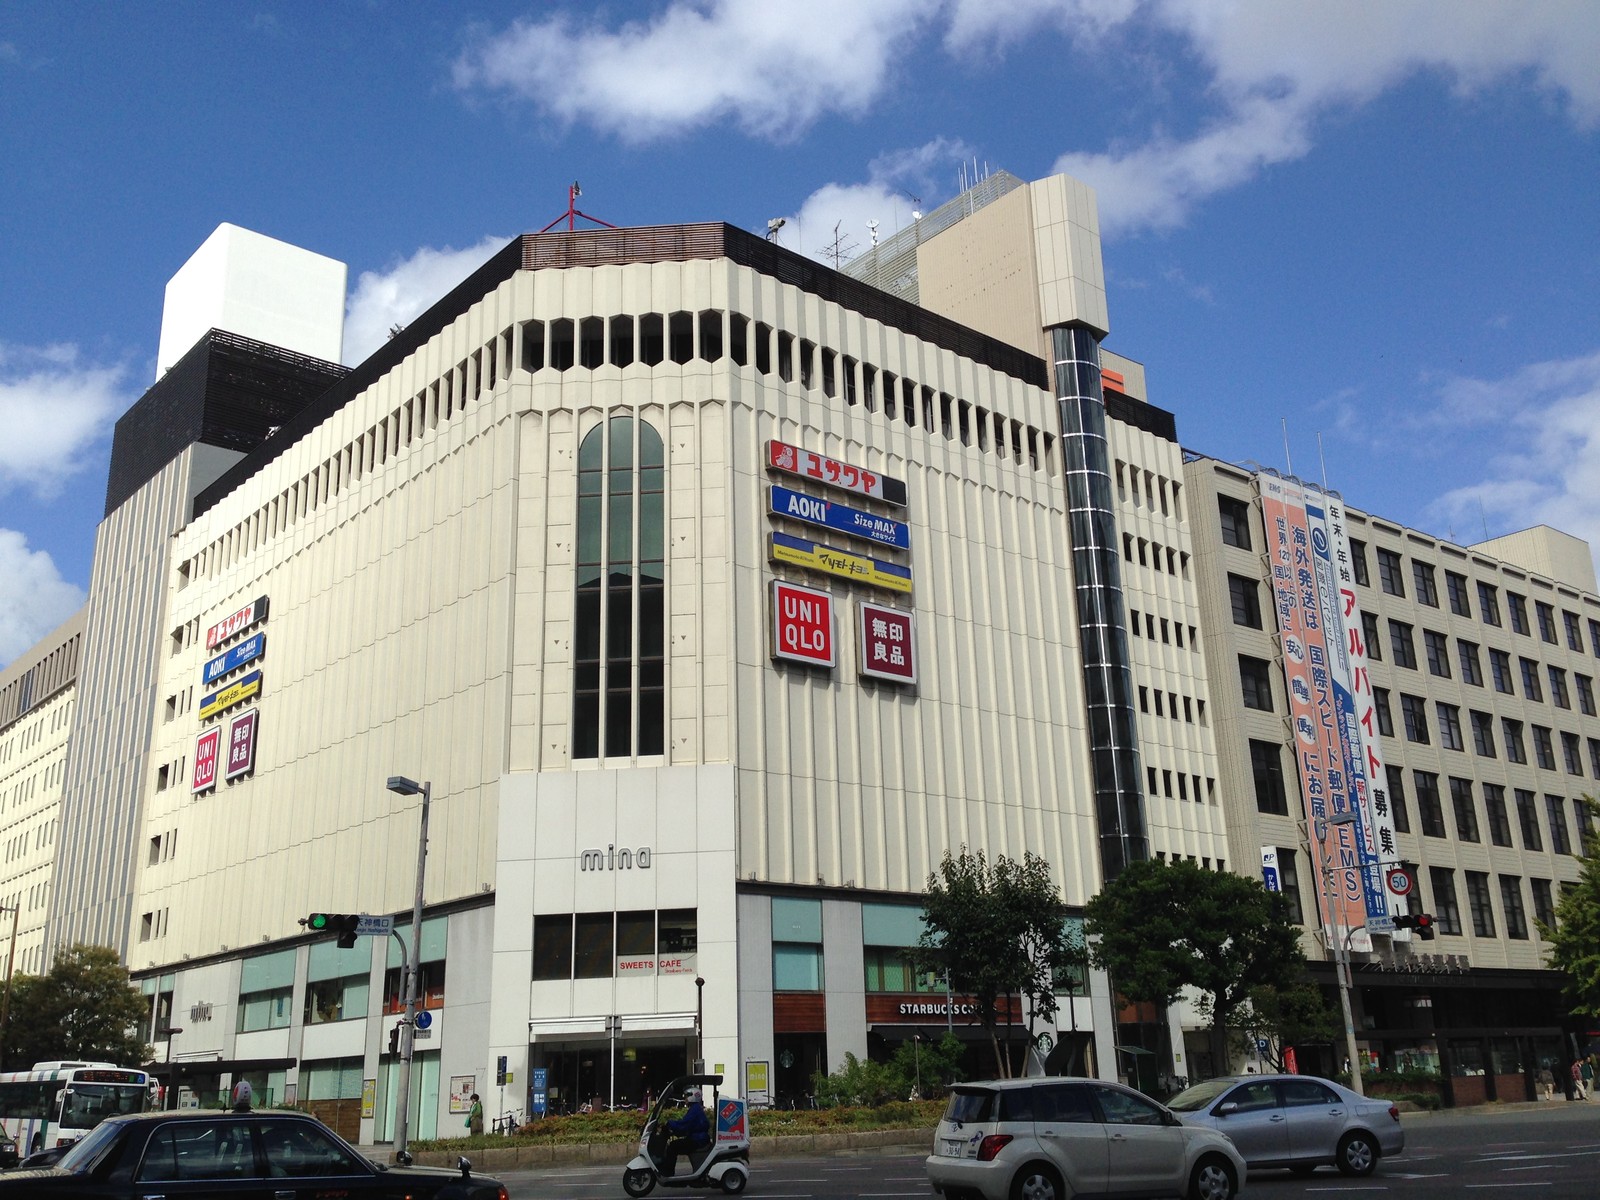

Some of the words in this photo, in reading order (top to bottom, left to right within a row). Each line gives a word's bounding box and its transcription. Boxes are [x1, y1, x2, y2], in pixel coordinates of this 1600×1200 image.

[788, 494, 826, 522] AOKI
[854, 513, 873, 529] Size
[874, 519, 896, 535] MAX
[1292, 524, 1320, 630] 海外発送は
[784, 596, 821, 625] UNI
[785, 623, 825, 651] QLO
[871, 618, 904, 642] 無印
[873, 641, 905, 666] 良品
[208, 656, 226, 679] AOKI
[1286, 639, 1304, 660] 安心
[1297, 717, 1315, 741] 便利
[1340, 587, 1381, 780] アルバイト
[234, 724, 250, 744] 無印
[198, 738, 214, 760] UNI
[231, 743, 247, 764] 良品
[196, 759, 213, 784] QLO
[1356, 780, 1375, 852] 新サービス
[580, 843, 651, 871] mina
[1392, 875, 1407, 889] 50
[619, 960, 654, 970] SWEETS
[659, 959, 682, 968] CAFE
[900, 1003, 960, 1015] STARBUCKS
